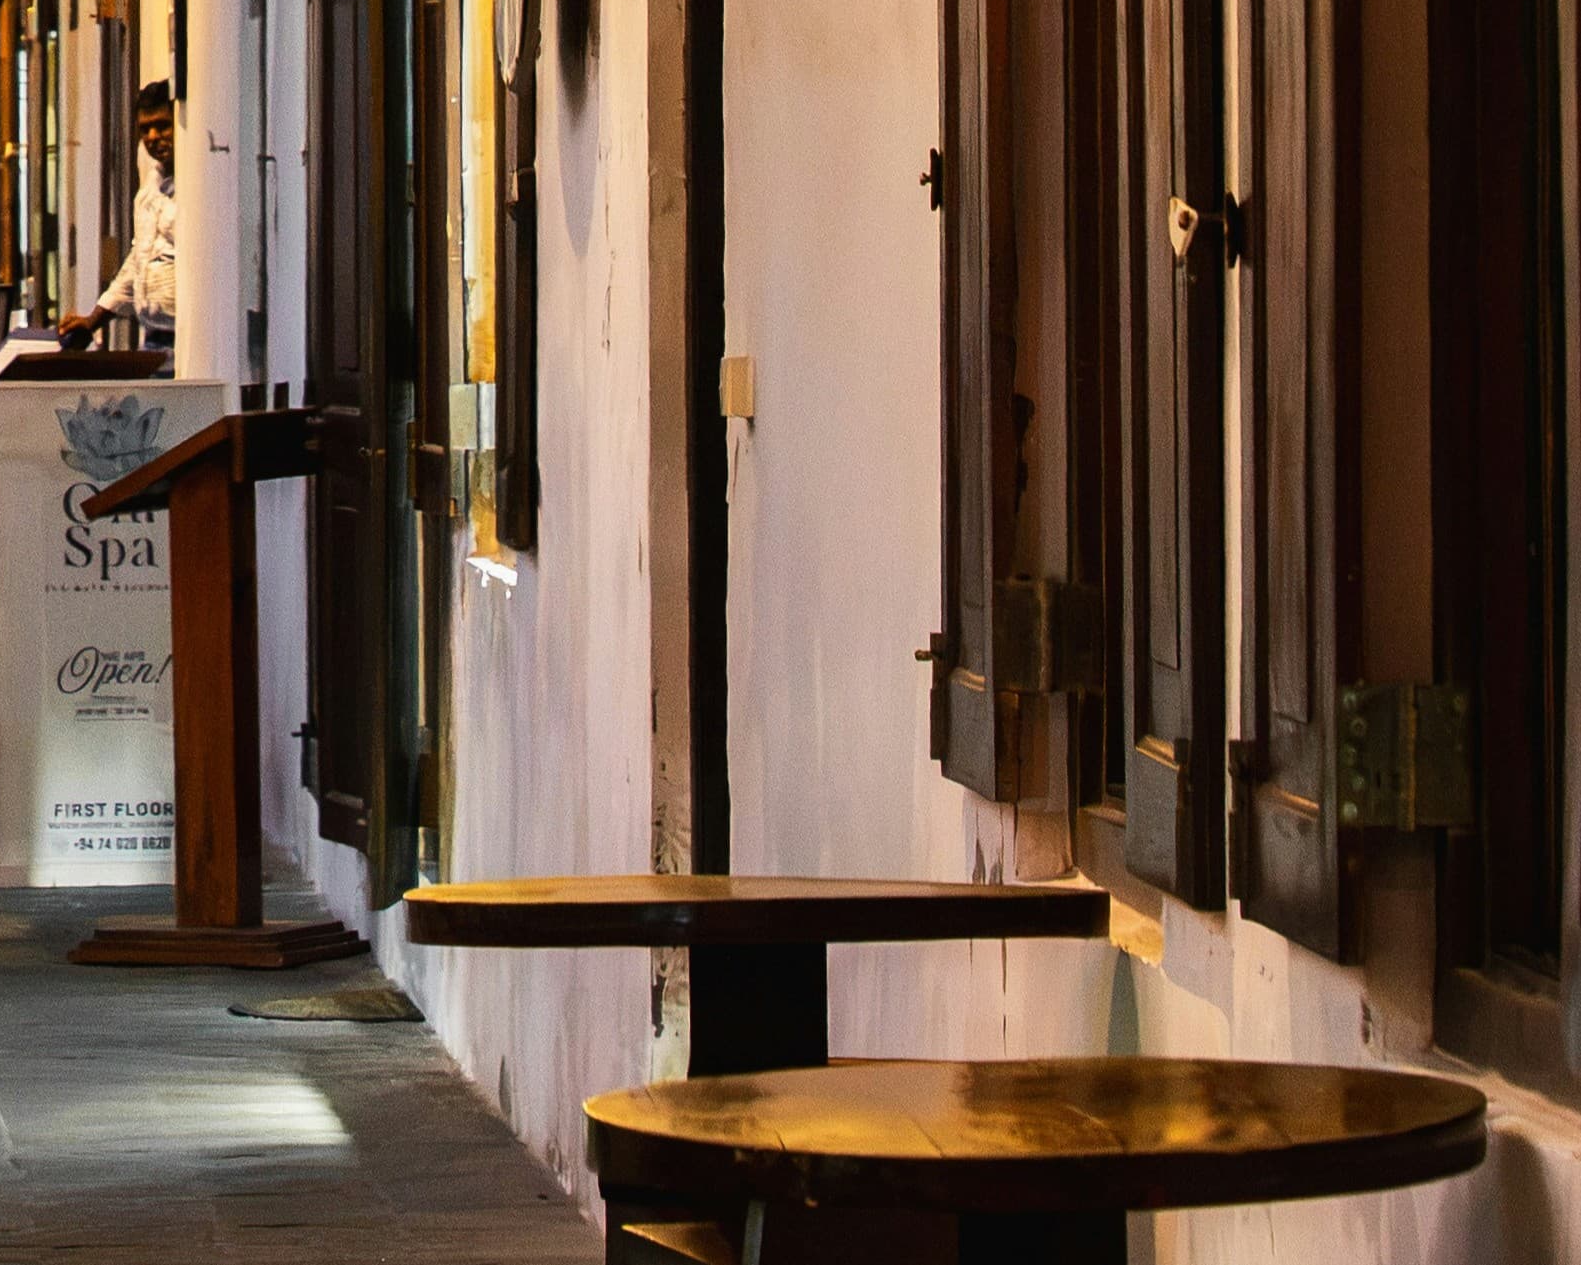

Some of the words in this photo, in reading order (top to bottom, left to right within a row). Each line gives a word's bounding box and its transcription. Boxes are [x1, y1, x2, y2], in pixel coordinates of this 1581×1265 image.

[64, 525, 158, 581] Spa
[57, 646, 173, 694] Open!
[54, 802, 107, 817] FIRST
[114, 801, 174, 817] FLOOR
